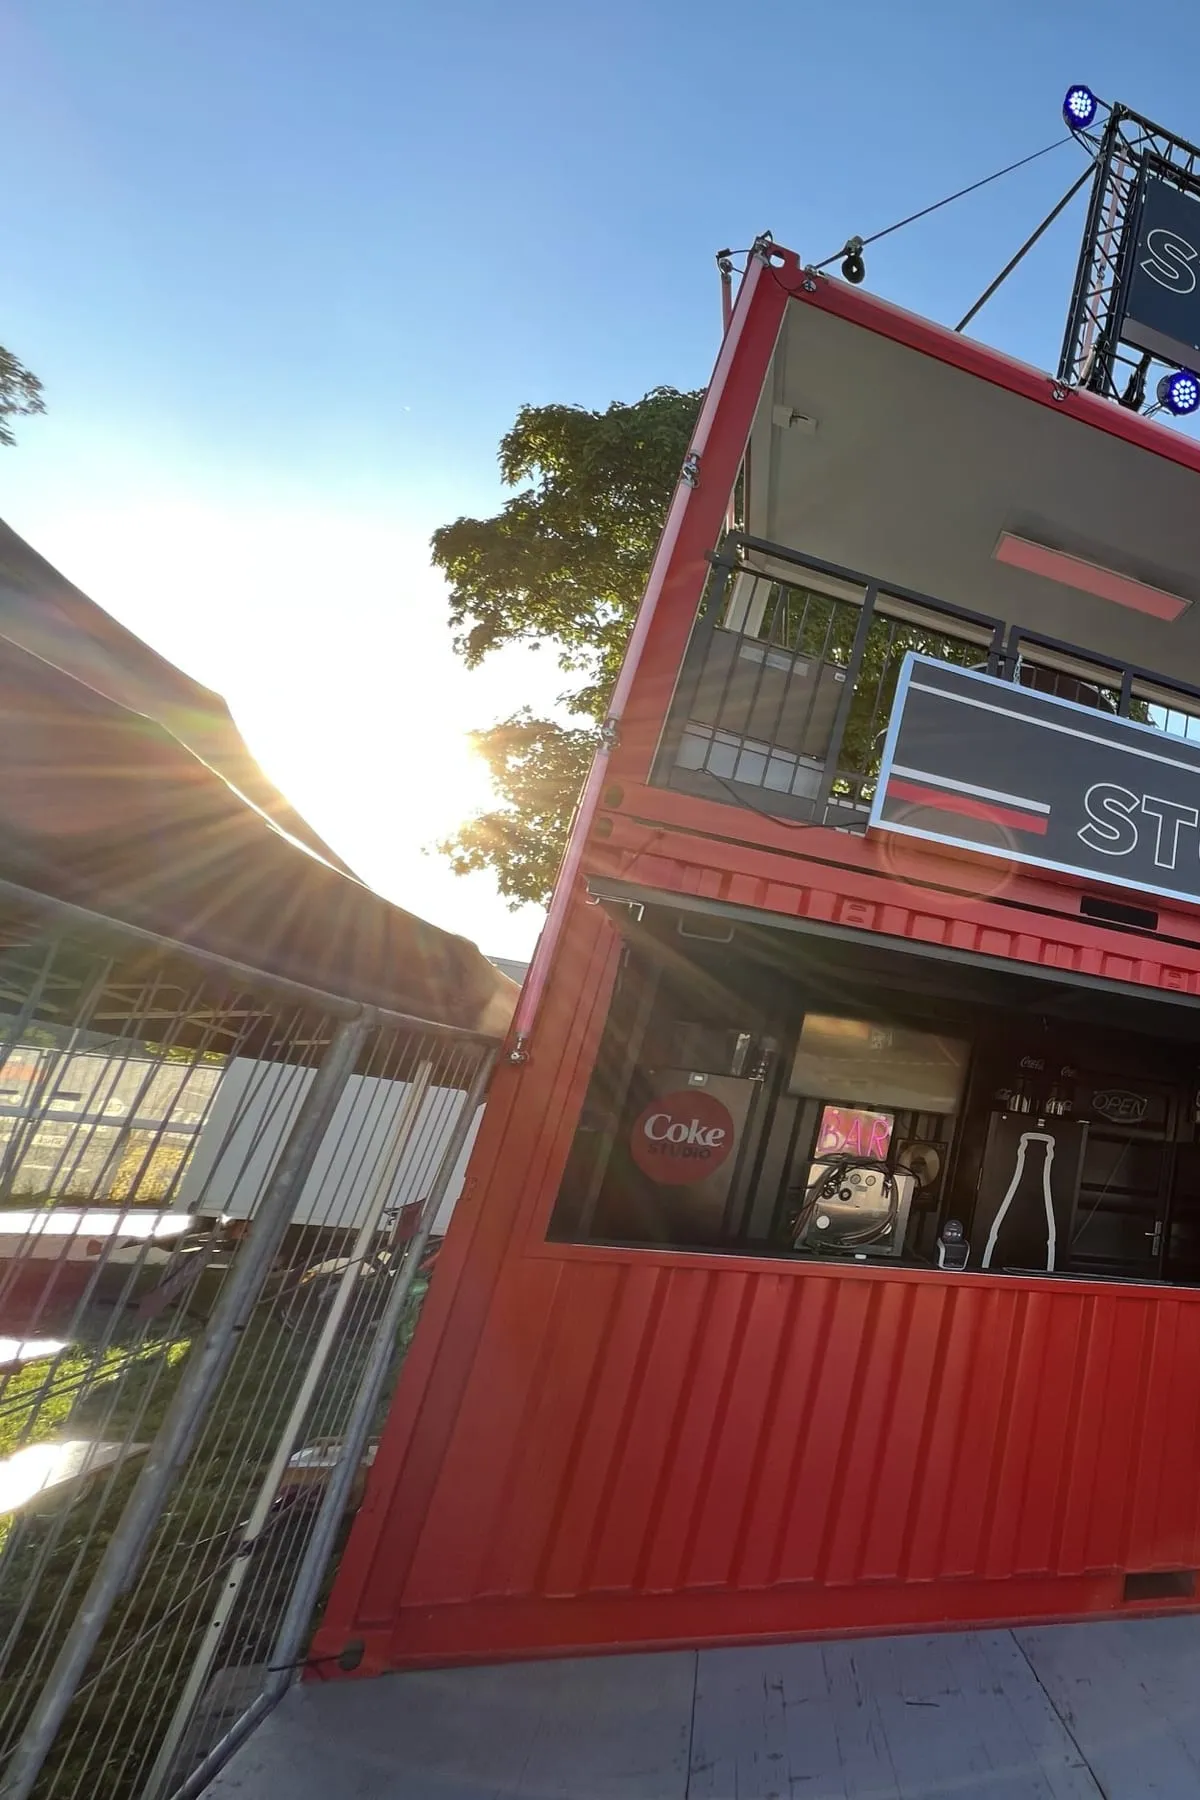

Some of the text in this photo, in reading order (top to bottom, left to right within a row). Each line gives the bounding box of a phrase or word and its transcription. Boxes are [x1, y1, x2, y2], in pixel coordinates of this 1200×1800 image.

[1092, 1095, 1148, 1117] OPEN
[643, 1113, 726, 1147] Coke
[818, 1109, 890, 1159] BAR
[647, 1143, 712, 1160] STUDIO
